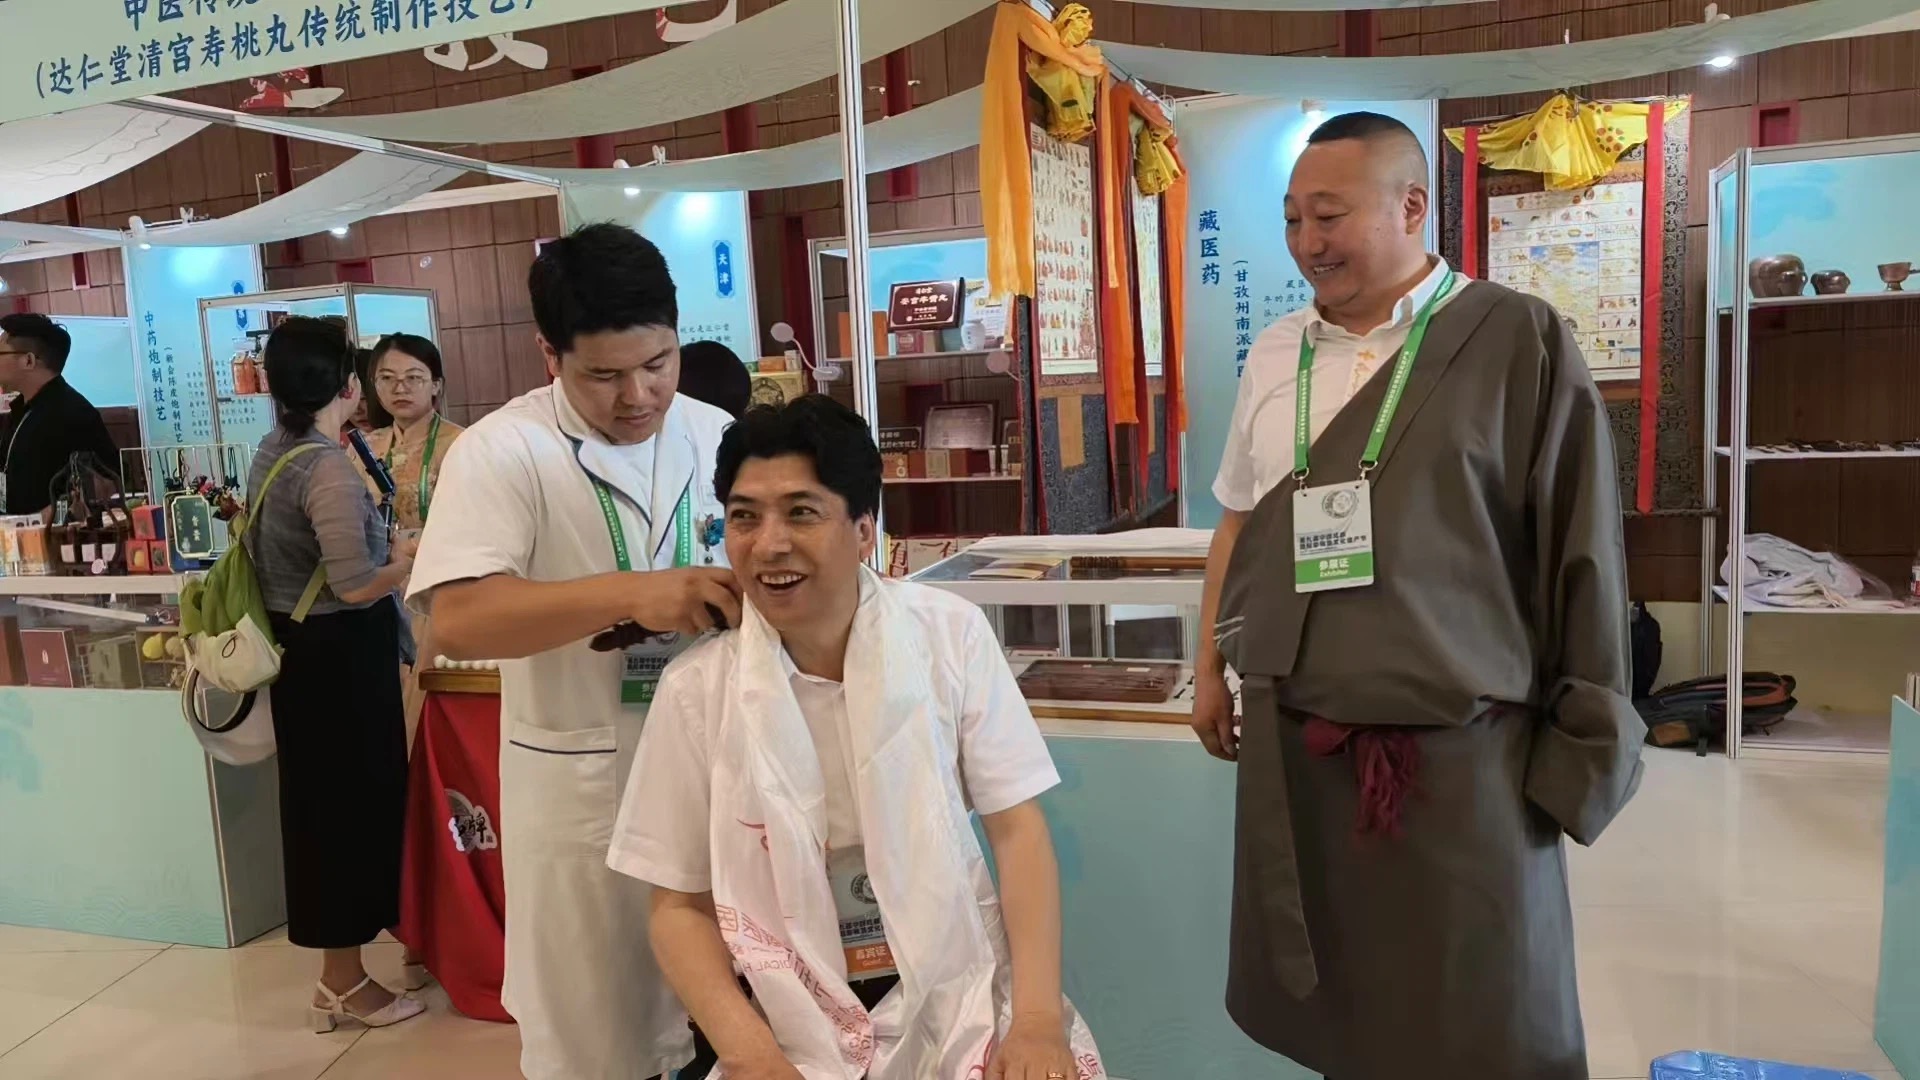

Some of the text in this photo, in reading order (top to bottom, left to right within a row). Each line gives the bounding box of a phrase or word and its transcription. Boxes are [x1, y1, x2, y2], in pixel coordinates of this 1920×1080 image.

[718, 253, 729, 284] 天津
[1199, 209, 1221, 286] 藏医药
[144, 311, 168, 421] 中药炮制技艺
